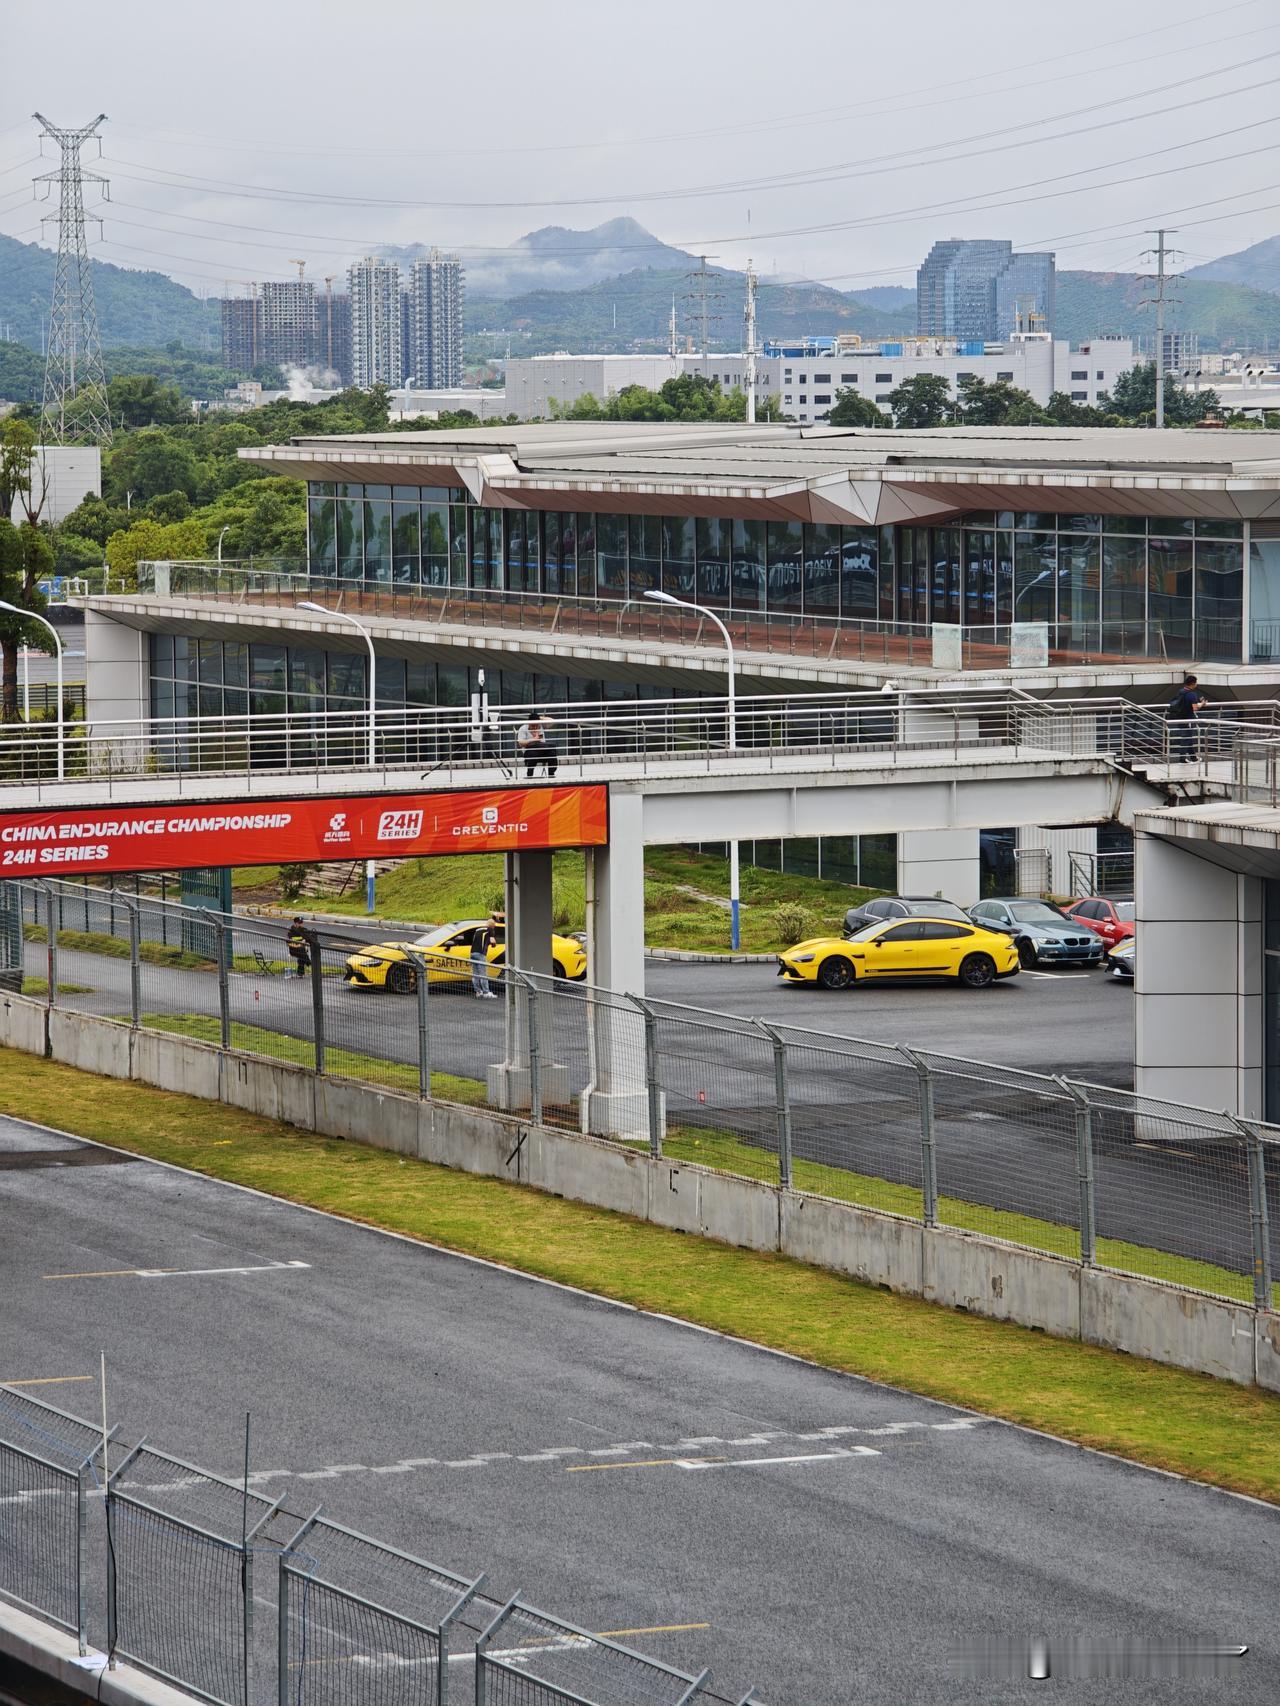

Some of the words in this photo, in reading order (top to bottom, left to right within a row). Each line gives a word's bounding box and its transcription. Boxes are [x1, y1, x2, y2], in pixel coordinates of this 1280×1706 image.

[1, 825, 57, 842] CHINA
[59, 819, 165, 839] ENDURANCE
[167, 814, 292, 833] CHAMPIONSHIP
[382, 813, 419, 830] 24H
[452, 823, 528, 836] CREVENTIC
[381, 829, 418, 838] SERIES
[2, 849, 37, 865] 24H
[40, 845, 109, 862] SERIES
